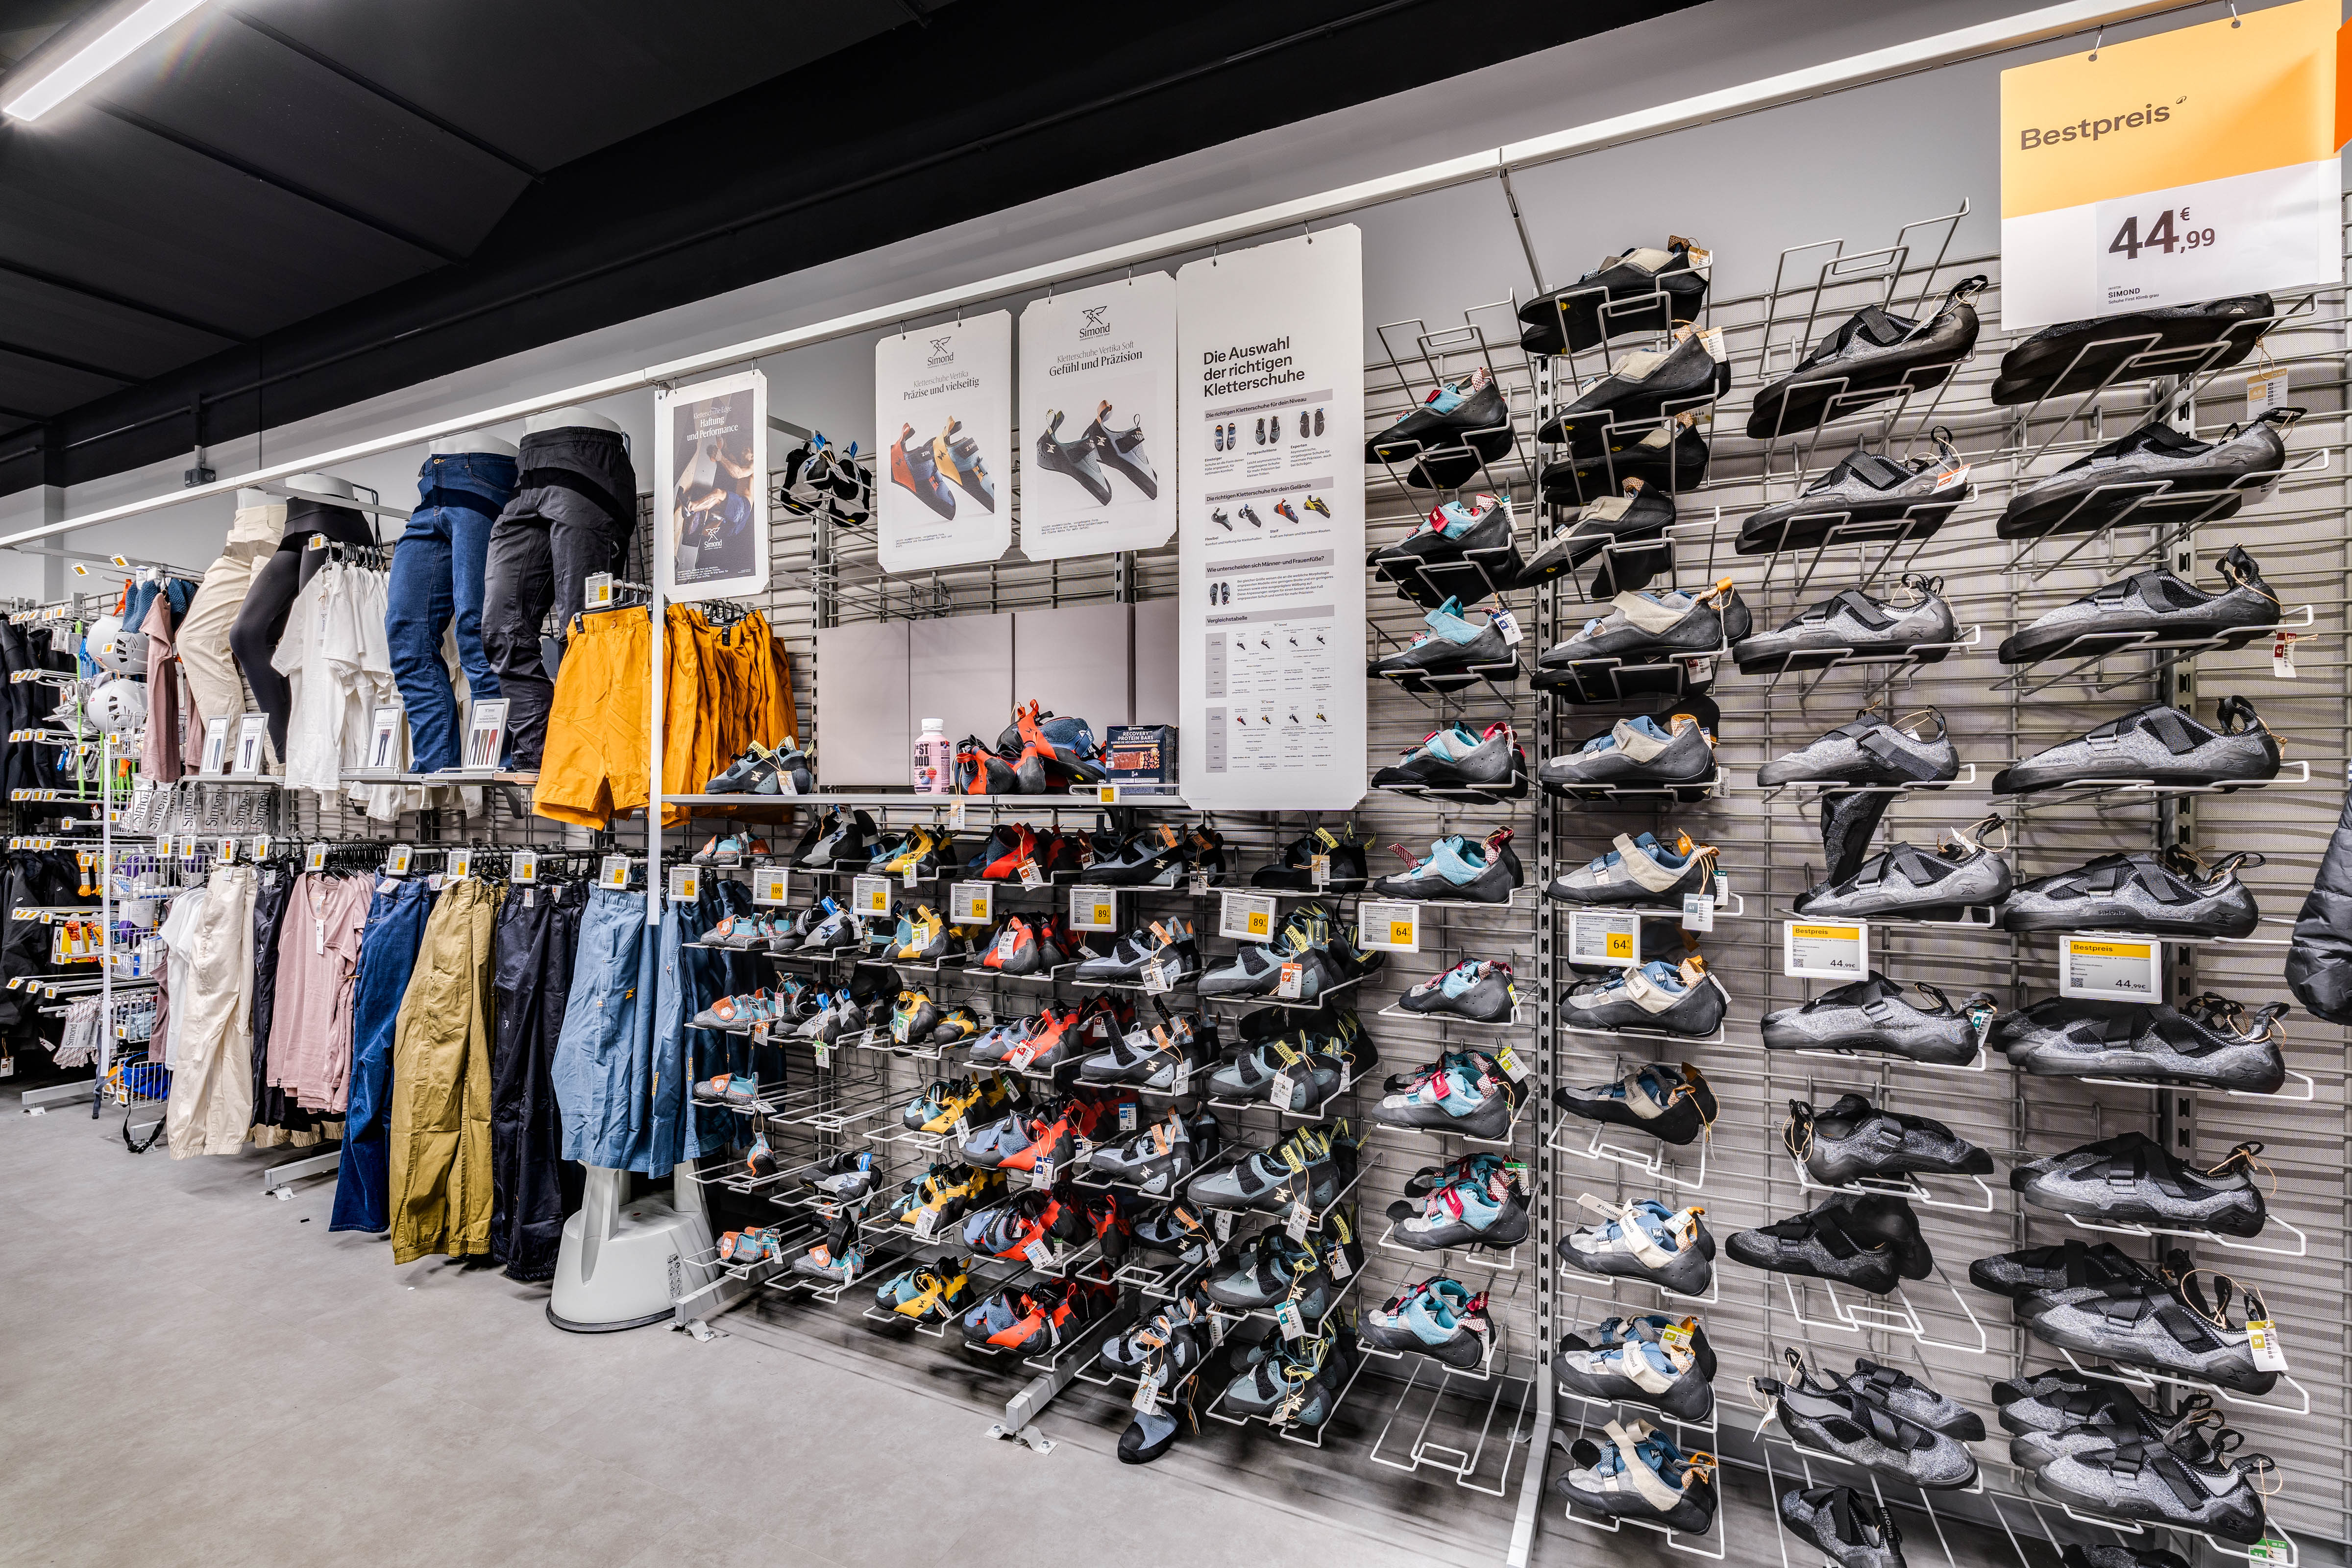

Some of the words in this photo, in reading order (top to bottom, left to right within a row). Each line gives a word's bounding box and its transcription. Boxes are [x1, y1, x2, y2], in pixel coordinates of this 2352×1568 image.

[2021, 103, 2170, 150] Bestpreis
[2108, 288, 2140, 298] SIMOND
[1080, 323, 1110, 338] Simond
[1057, 349, 1098, 364] Kletterschuhe
[1099, 344, 1120, 353] Vertika
[1122, 341, 1133, 350] Soft
[1204, 351, 1226, 365] Die
[1228, 336, 1289, 360] Auswahl
[928, 352, 954, 366] Simond
[1050, 362, 1078, 376] Gefühl
[1081, 358, 1099, 370] und
[1102, 351, 1142, 366] Präzision
[1204, 368, 1226, 381] der
[1229, 356, 1292, 376] richtigen
[914, 375, 949, 388] Kletterschuhe
[950, 370, 968, 380] Vertika
[1204, 369, 1304, 397] Kletterschuhe
[904, 389, 928, 400] Präzise
[930, 384, 944, 395] und
[946, 377, 979, 391] vielseitig
[694, 409, 720, 419] Kletterschuhe
[721, 406, 732, 414] Edge
[1236, 404, 1270, 414] Kletterschuhe
[700, 416, 725, 428] Haftung
[687, 431, 699, 441] und
[700, 423, 738, 439] Performance
[1237, 489, 1270, 497] Kletterschuhe
[704, 539, 722, 548] Simond
[1316, 829, 1333, 845] VERTIK
[1152, 924, 1166, 939] VERTIK
[1287, 928, 1303, 948] VERTIK
[1396, 928, 1407, 936] 64
[1614, 940, 1626, 949] 64
[1831, 959, 1855, 968] 44,99€
[2115, 980, 2146, 989] 44,99€
[66, 1024, 77, 1046] Simond
[1275, 1043, 1292, 1061] VERTIK
[1152, 1126, 1162, 1146] VERTIK
[1307, 1141, 1321, 1155] SIMOND
[1283, 1148, 1297, 1169] VERTIK
[1601, 1206, 1621, 1218] SIMOND
[1335, 1217, 1347, 1237] VERTIK
[2111, 1345, 2137, 1353] SIMOND
[1628, 1349, 1638, 1369] Simond
